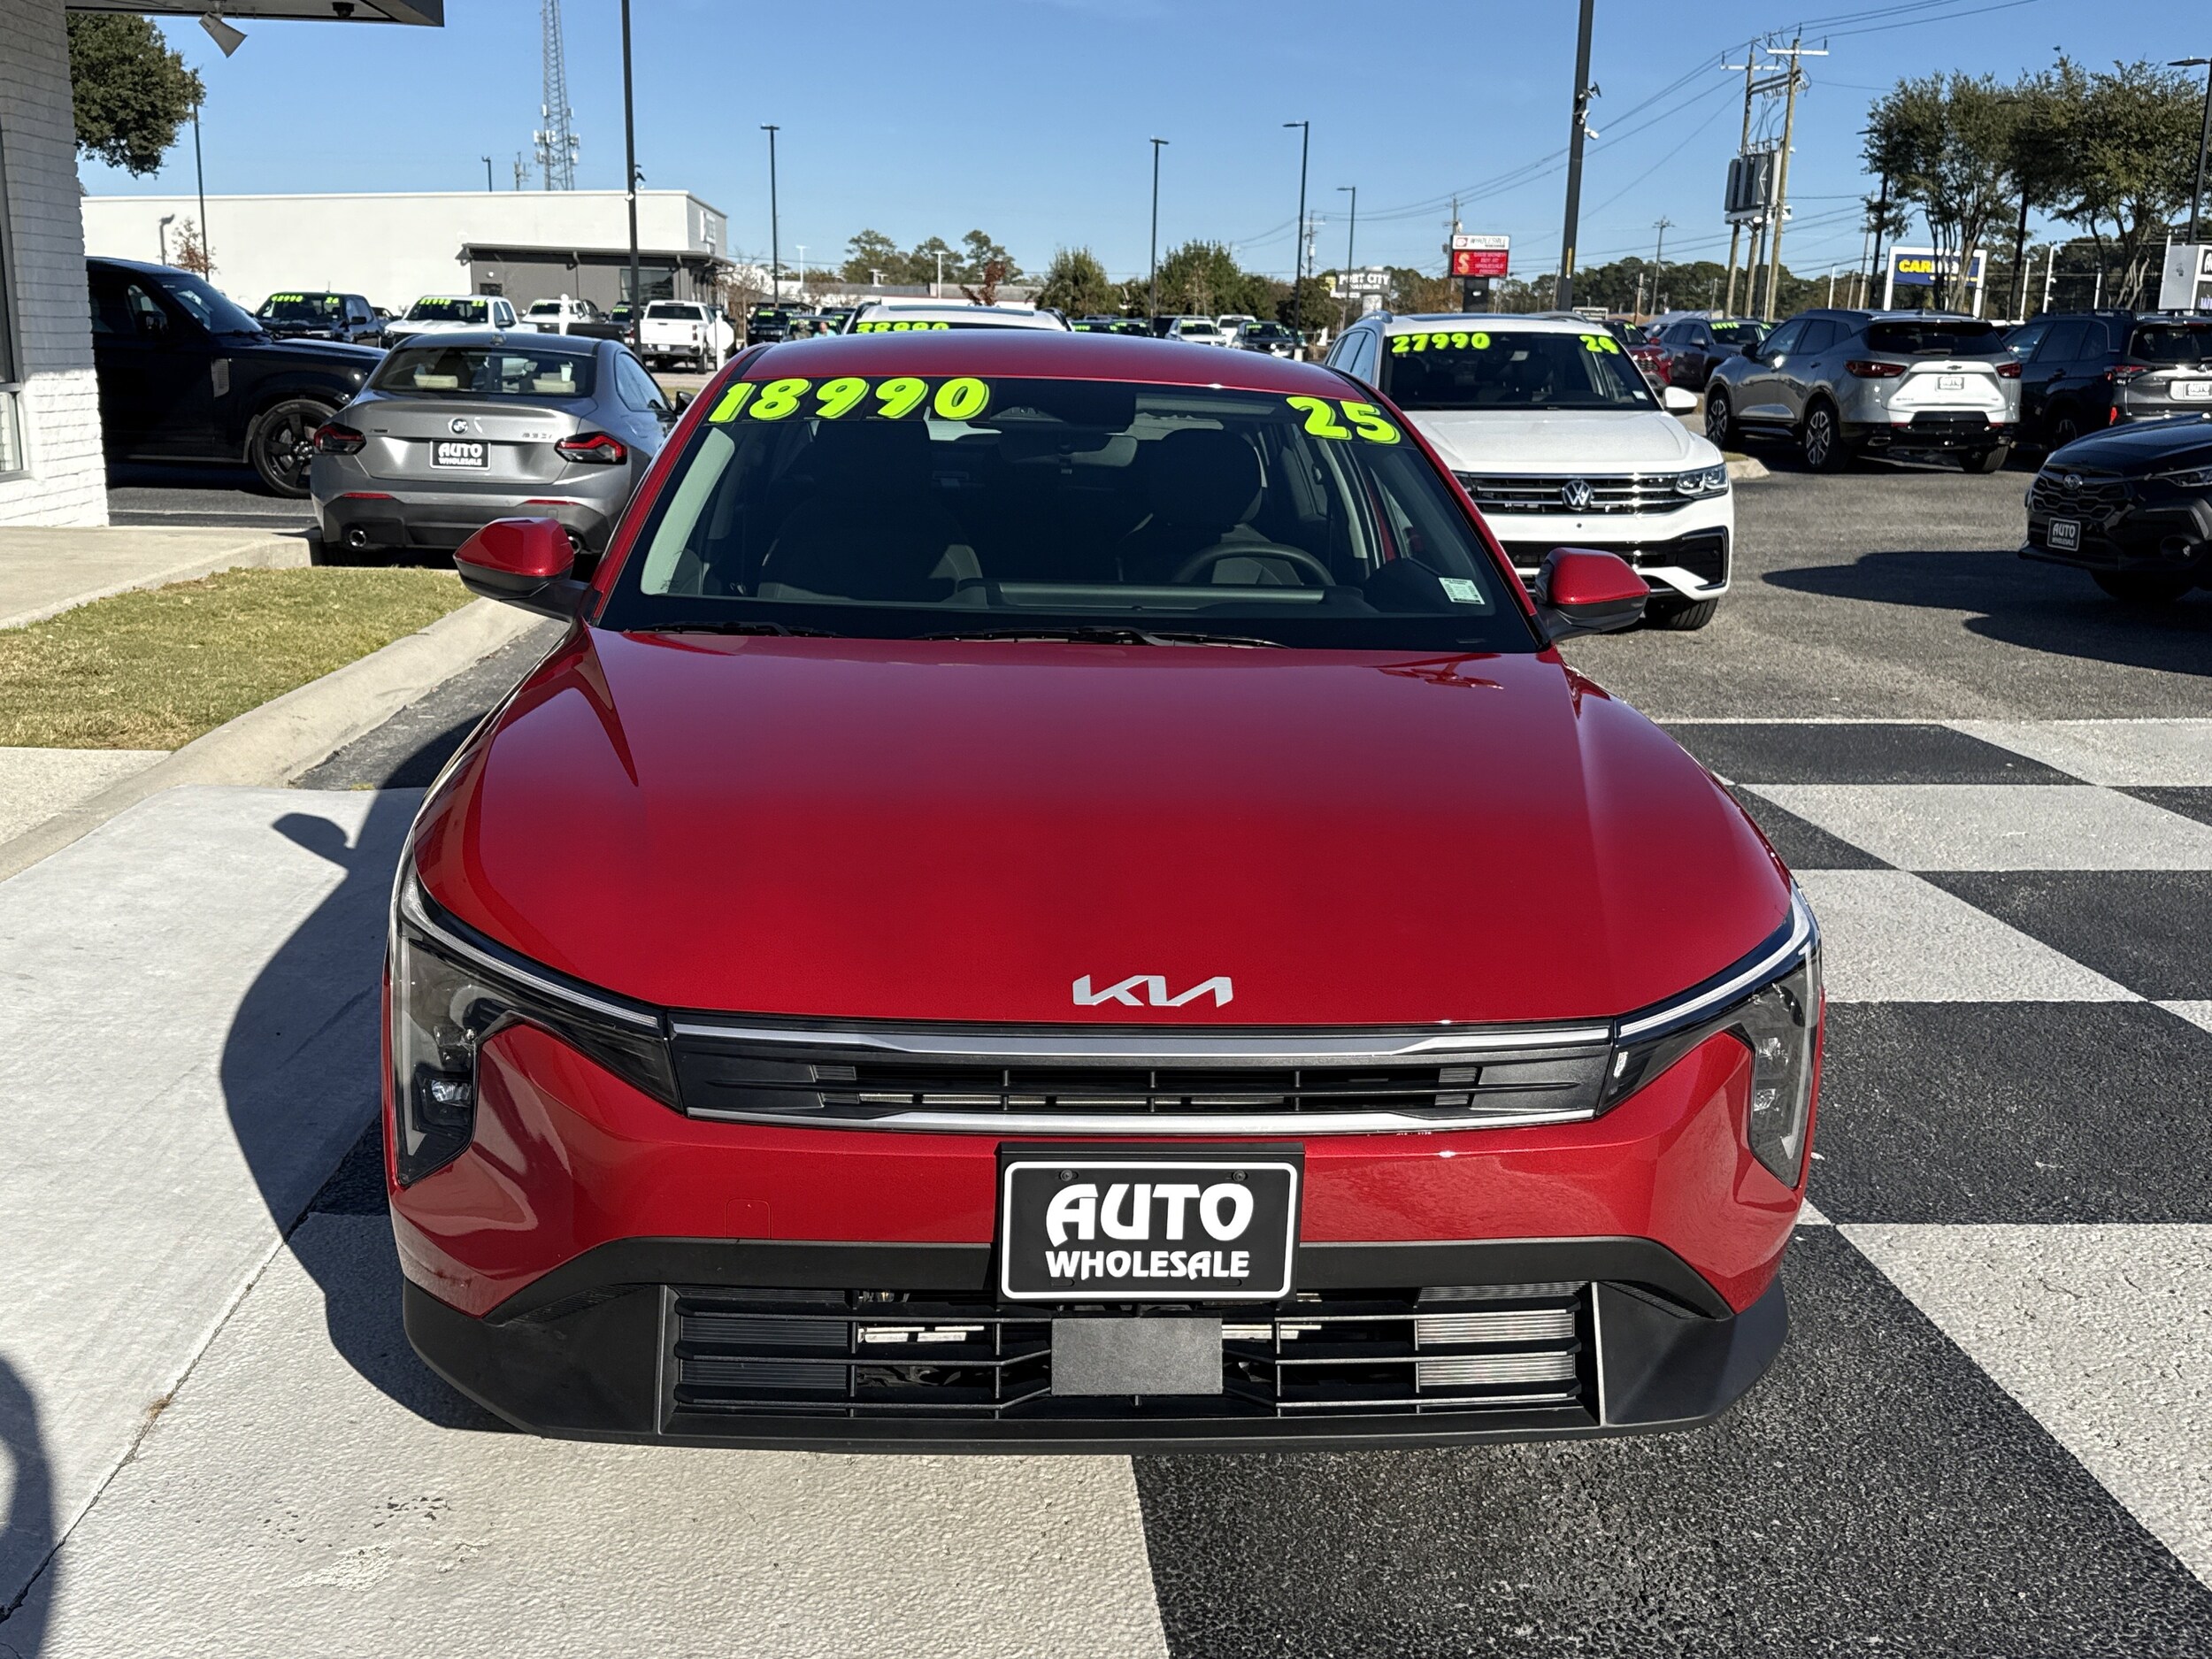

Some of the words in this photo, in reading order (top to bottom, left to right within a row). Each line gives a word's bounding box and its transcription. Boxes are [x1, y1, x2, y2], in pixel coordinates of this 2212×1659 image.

[1367, 273, 1389, 285] CITY
[1392, 332, 1491, 353] 27990
[1579, 334, 1620, 354] 24
[708, 377, 990, 424] 18990
[1286, 396, 1402, 444] 25
[438, 442, 483, 458] AUTO
[438, 457, 482, 466] WHOLESALE
[2053, 523, 2076, 538] AUTO
[1072, 974, 1233, 1008] KIA
[1046, 1183, 1254, 1248] AUTO
[1045, 1250, 1250, 1280] WHOLESALE
